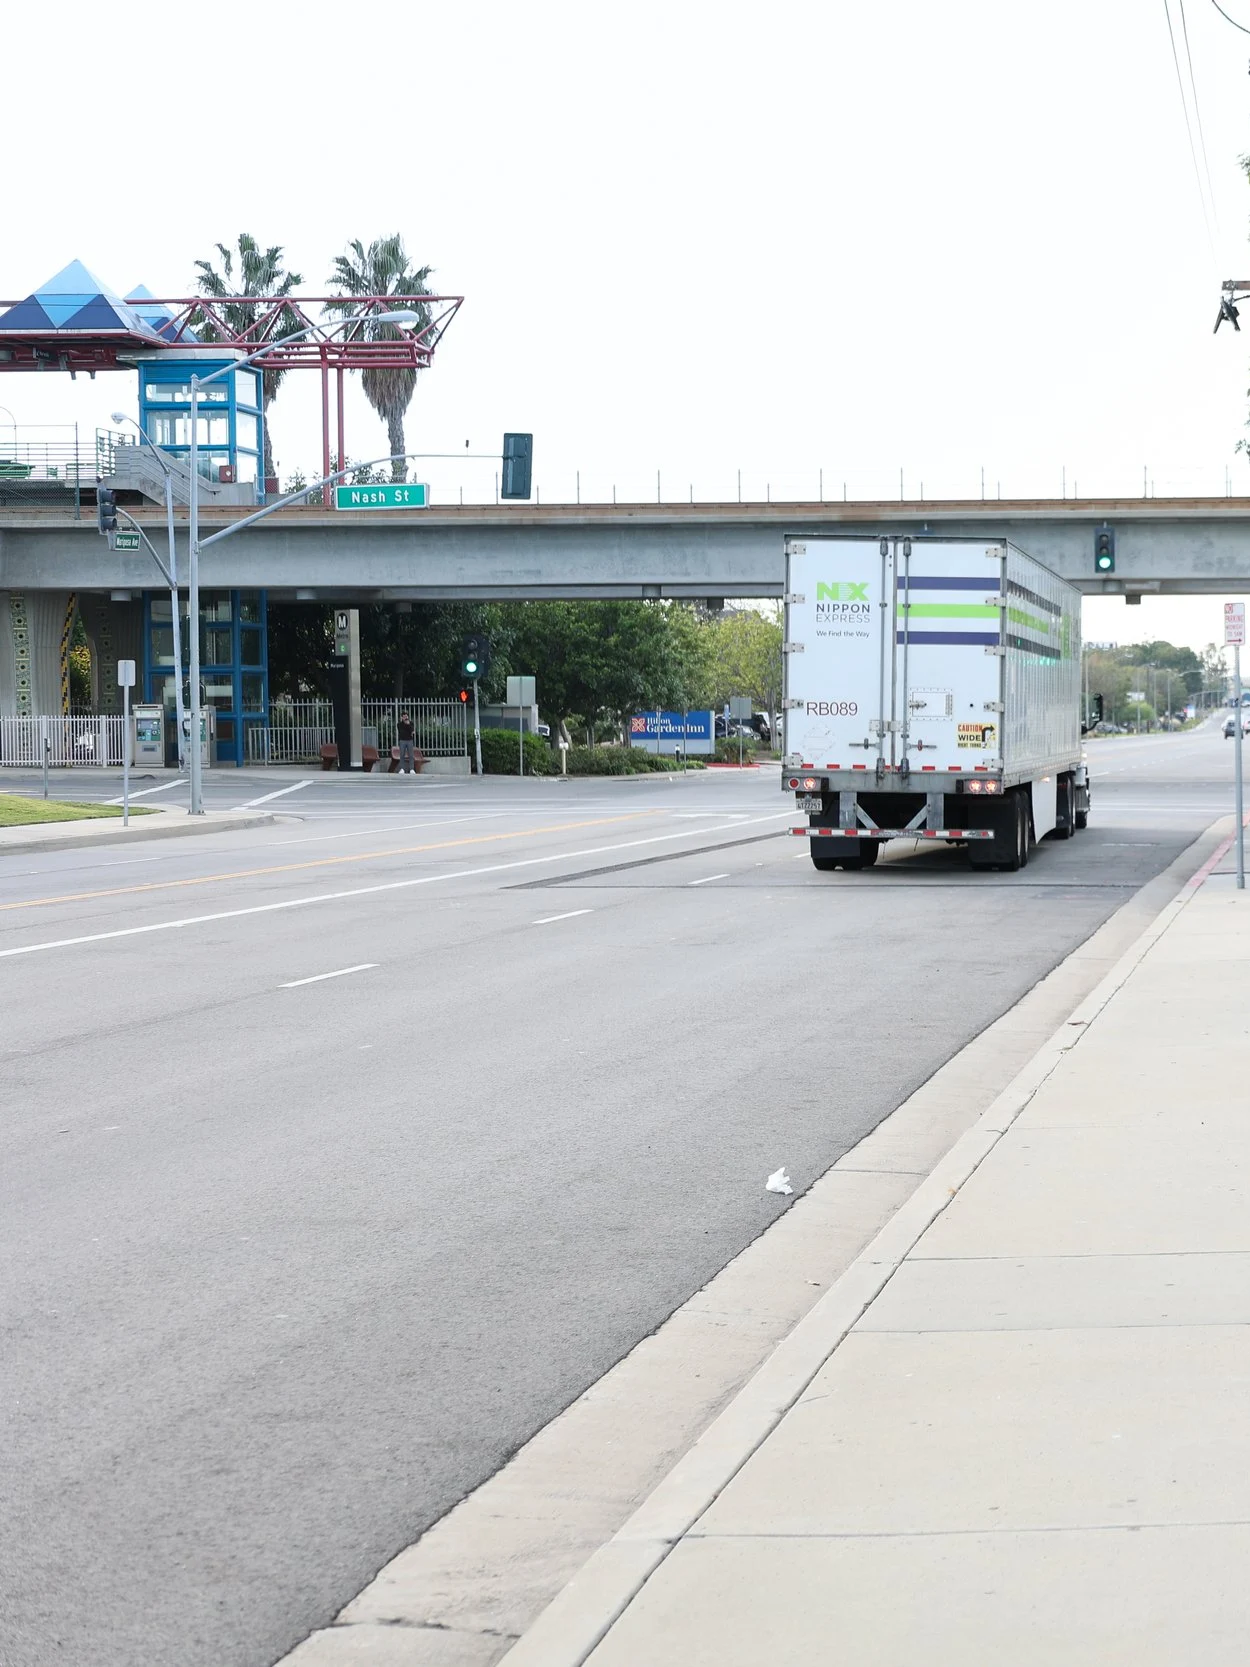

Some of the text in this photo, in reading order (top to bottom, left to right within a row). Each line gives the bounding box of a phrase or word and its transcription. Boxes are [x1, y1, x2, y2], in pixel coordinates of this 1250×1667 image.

[351, 489, 409, 504] Nash St
[816, 582, 870, 601] NX
[816, 603, 870, 613] NIPPON
[816, 614, 870, 623] EXPRESS
[856, 630, 869, 639] Way
[806, 702, 858, 716] RB089
[646, 723, 705, 733] Garden Inn
[957, 724, 983, 732] CAUTION
